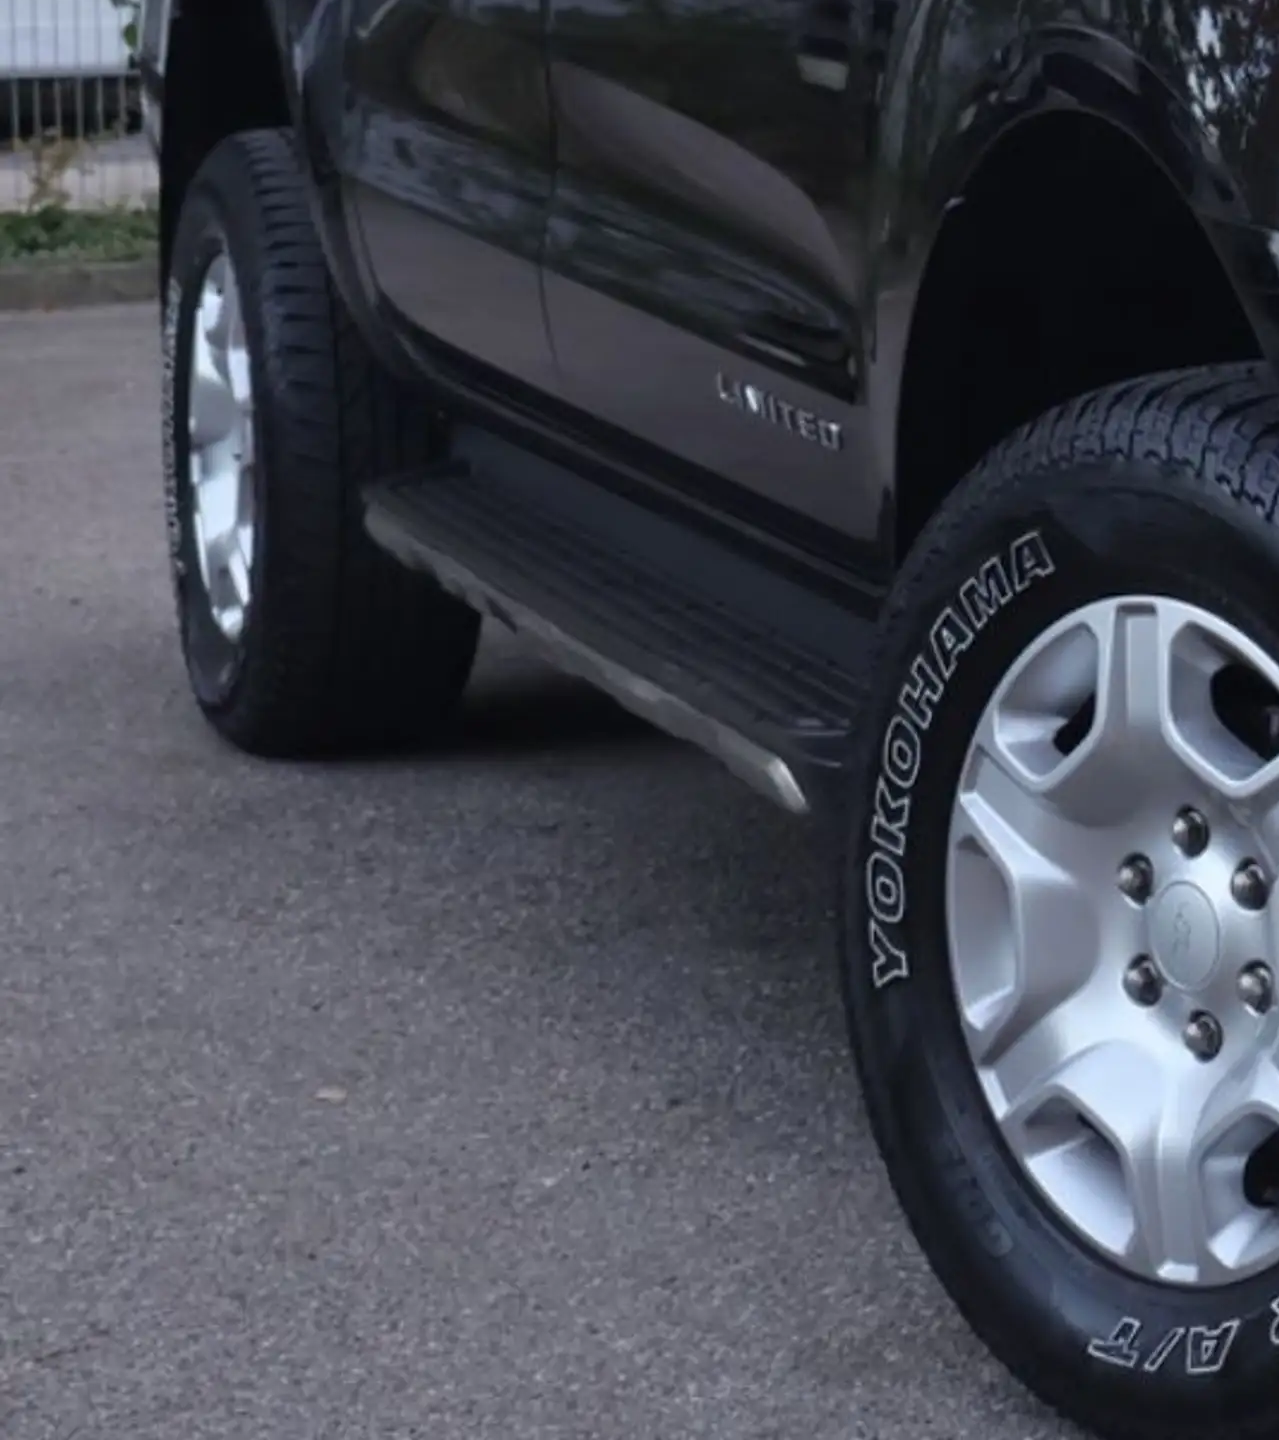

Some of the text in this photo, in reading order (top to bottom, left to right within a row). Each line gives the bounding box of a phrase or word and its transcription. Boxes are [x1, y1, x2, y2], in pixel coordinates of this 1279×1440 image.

[715, 368, 842, 451] LIMITED
[866, 530, 1055, 988] YOKOHAMA
[1088, 1317, 1239, 1373] A/T
